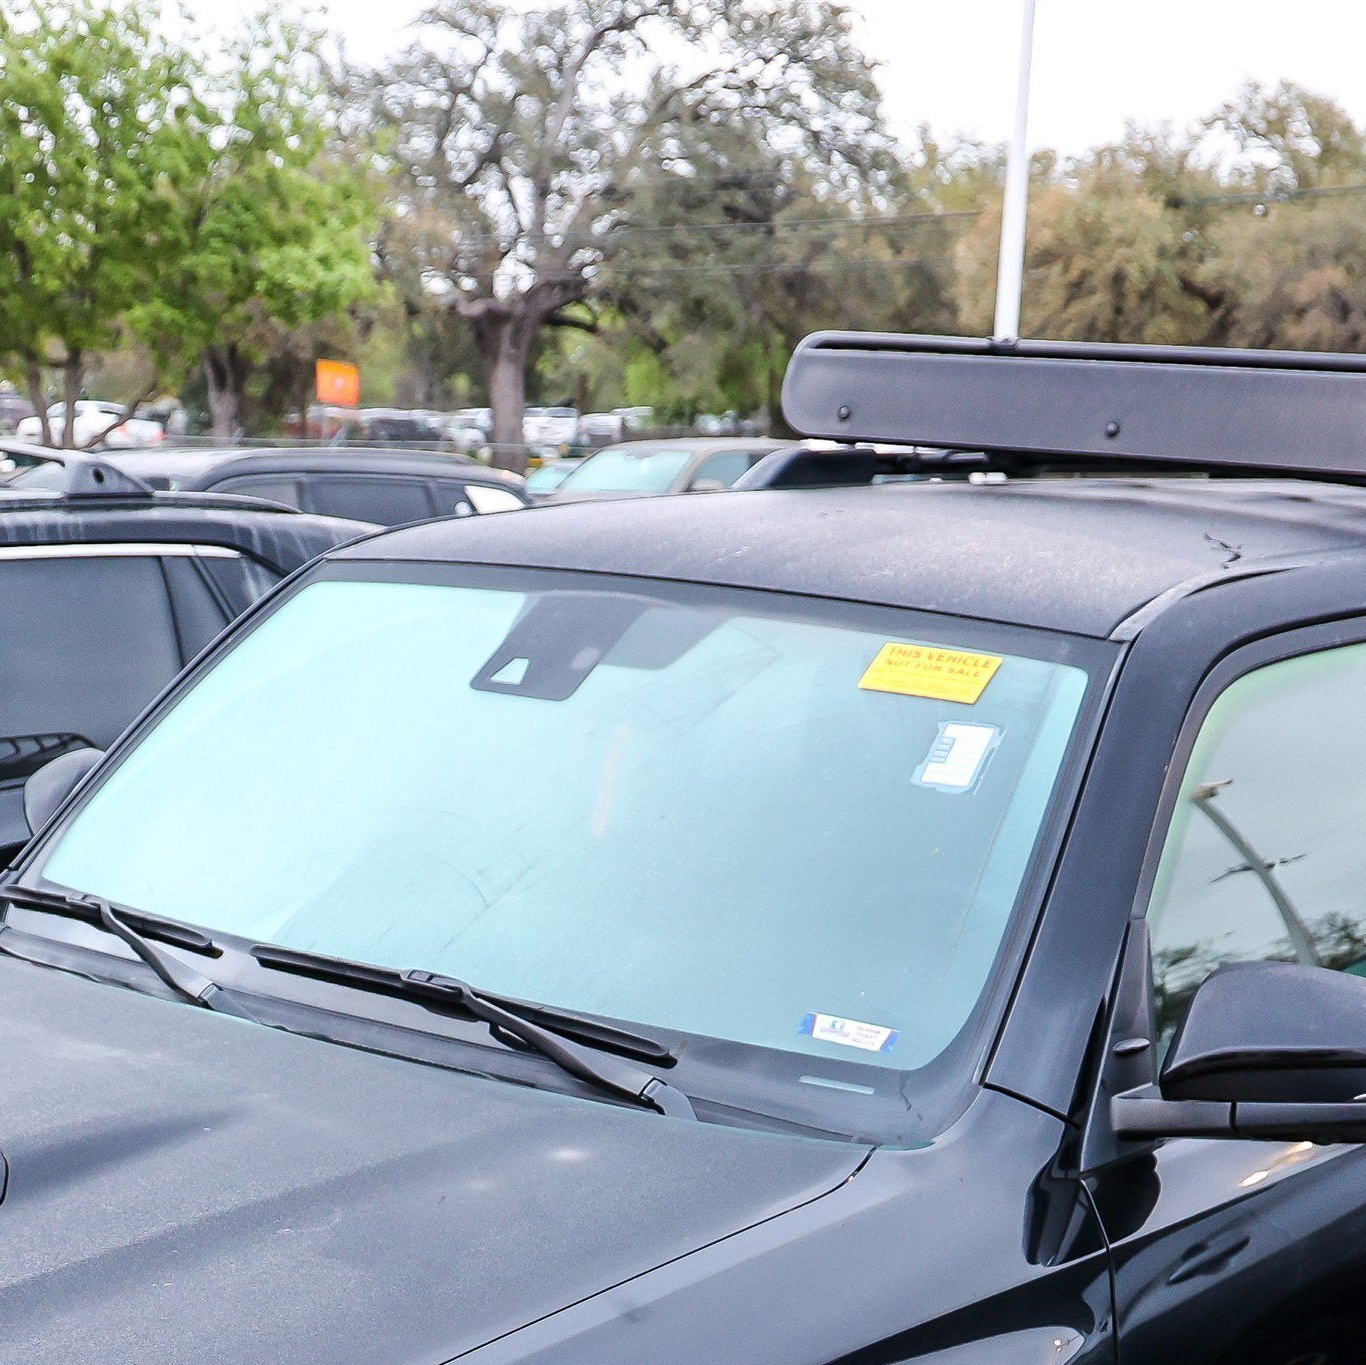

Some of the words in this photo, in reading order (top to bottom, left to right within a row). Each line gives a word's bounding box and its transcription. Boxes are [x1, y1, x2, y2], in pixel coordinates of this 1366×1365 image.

[884, 658, 911, 668] NOT
[913, 662, 944, 673] FOR
[947, 667, 982, 678] SALE
[888, 647, 924, 660] THIS
[927, 652, 993, 669] VEHICLE
